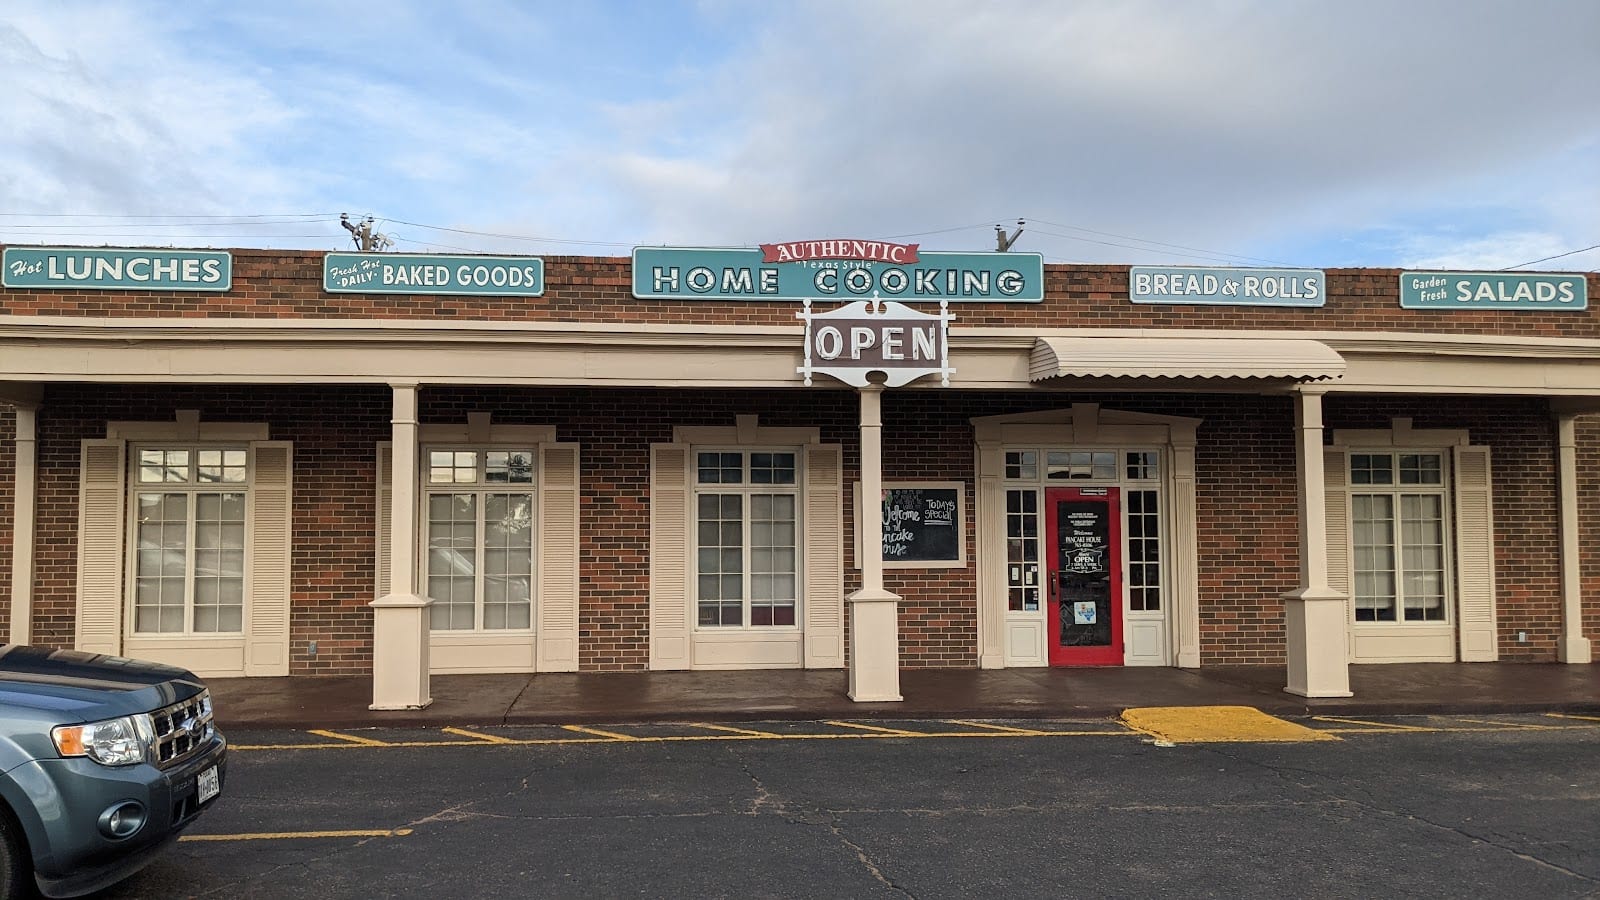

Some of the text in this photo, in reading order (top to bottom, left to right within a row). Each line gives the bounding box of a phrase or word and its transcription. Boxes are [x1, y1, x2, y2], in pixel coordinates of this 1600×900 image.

[777, 240, 907, 263] AUTHENTIC
[10, 256, 222, 283] Hot LUNCHES
[330, 258, 381, 280] Fresh Hot
[383, 265, 535, 288] BAKED GOODS
[652, 266, 1026, 296] HOME COOKING
[1135, 274, 1319, 299] BREAD & ROLLS
[1412, 277, 1447, 289] Garden
[1456, 281, 1575, 303] SALADS
[1420, 288, 1447, 302] Fresh
[815, 326, 936, 361] OPEN
